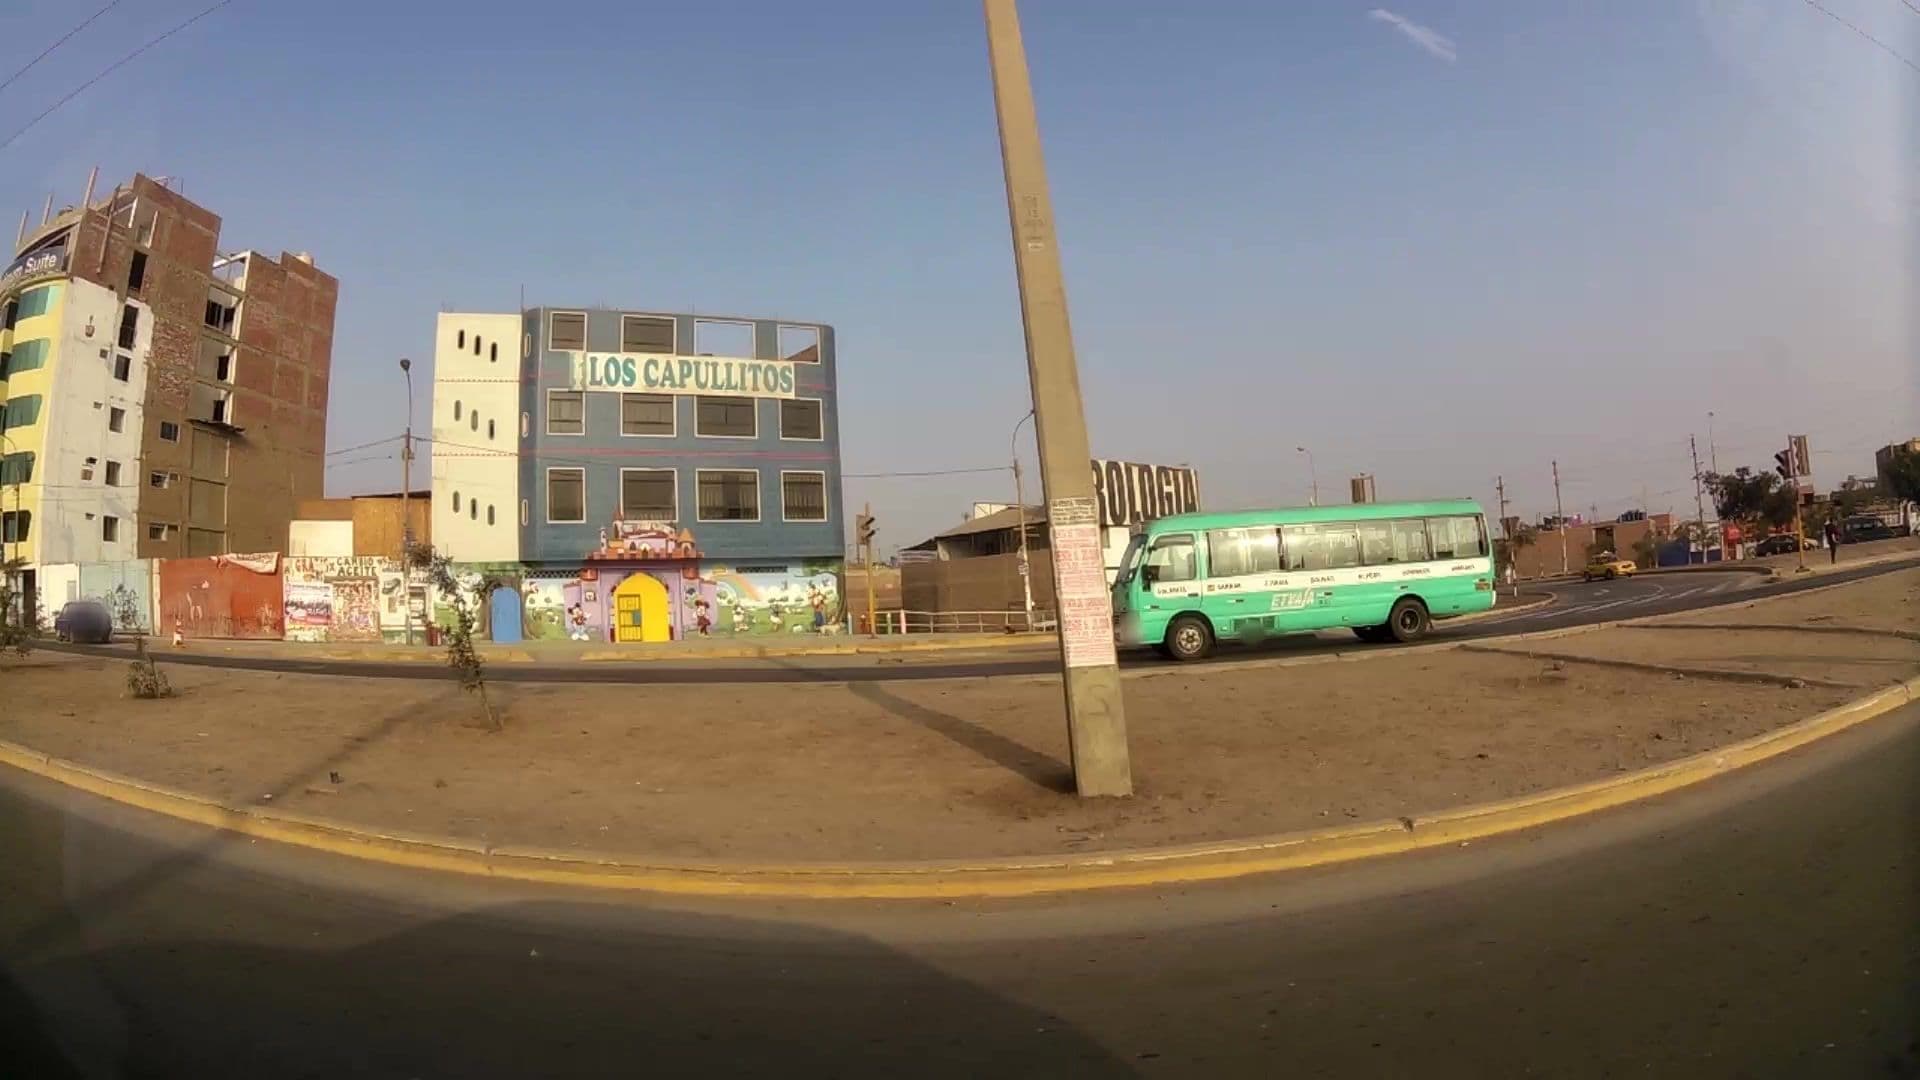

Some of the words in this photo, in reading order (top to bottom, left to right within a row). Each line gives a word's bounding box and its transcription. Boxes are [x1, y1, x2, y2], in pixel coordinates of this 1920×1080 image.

[25, 253, 57, 272] Suite
[589, 356, 637, 387] LOS
[643, 358, 793, 393] CAPULLITOS
[336, 566, 377, 577] ACEITE
